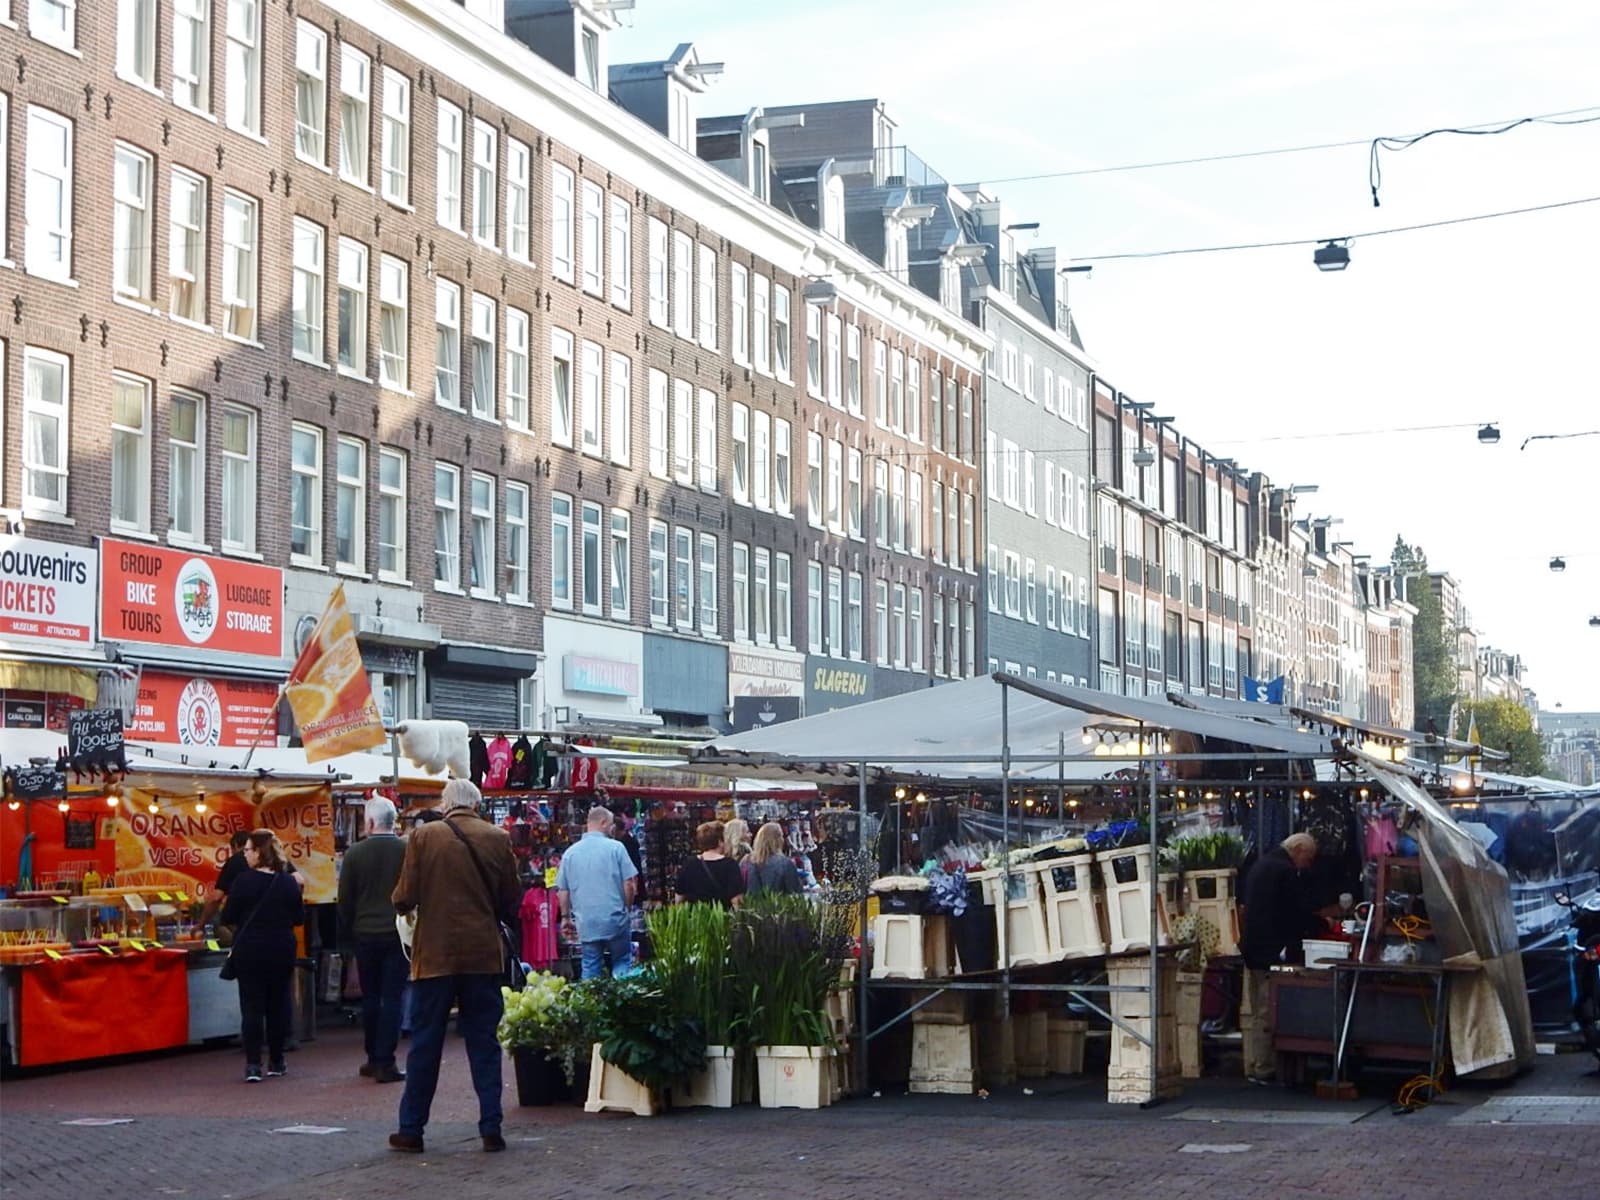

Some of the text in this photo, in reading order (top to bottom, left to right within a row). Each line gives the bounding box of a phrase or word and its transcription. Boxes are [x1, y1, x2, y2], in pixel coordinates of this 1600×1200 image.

[0, 550, 87, 584] ouvenirs
[121, 552, 162, 577] GROUP
[127, 581, 157, 606] BIKE
[226, 584, 271, 607] LUGGAGE
[121, 609, 162, 634] TOURS
[226, 611, 273, 634] STORAGE
[814, 667, 867, 696] SLAGERIJ
[131, 812, 242, 836] ORANGE
[260, 803, 331, 830] JUICE
[148, 845, 203, 867] vers
